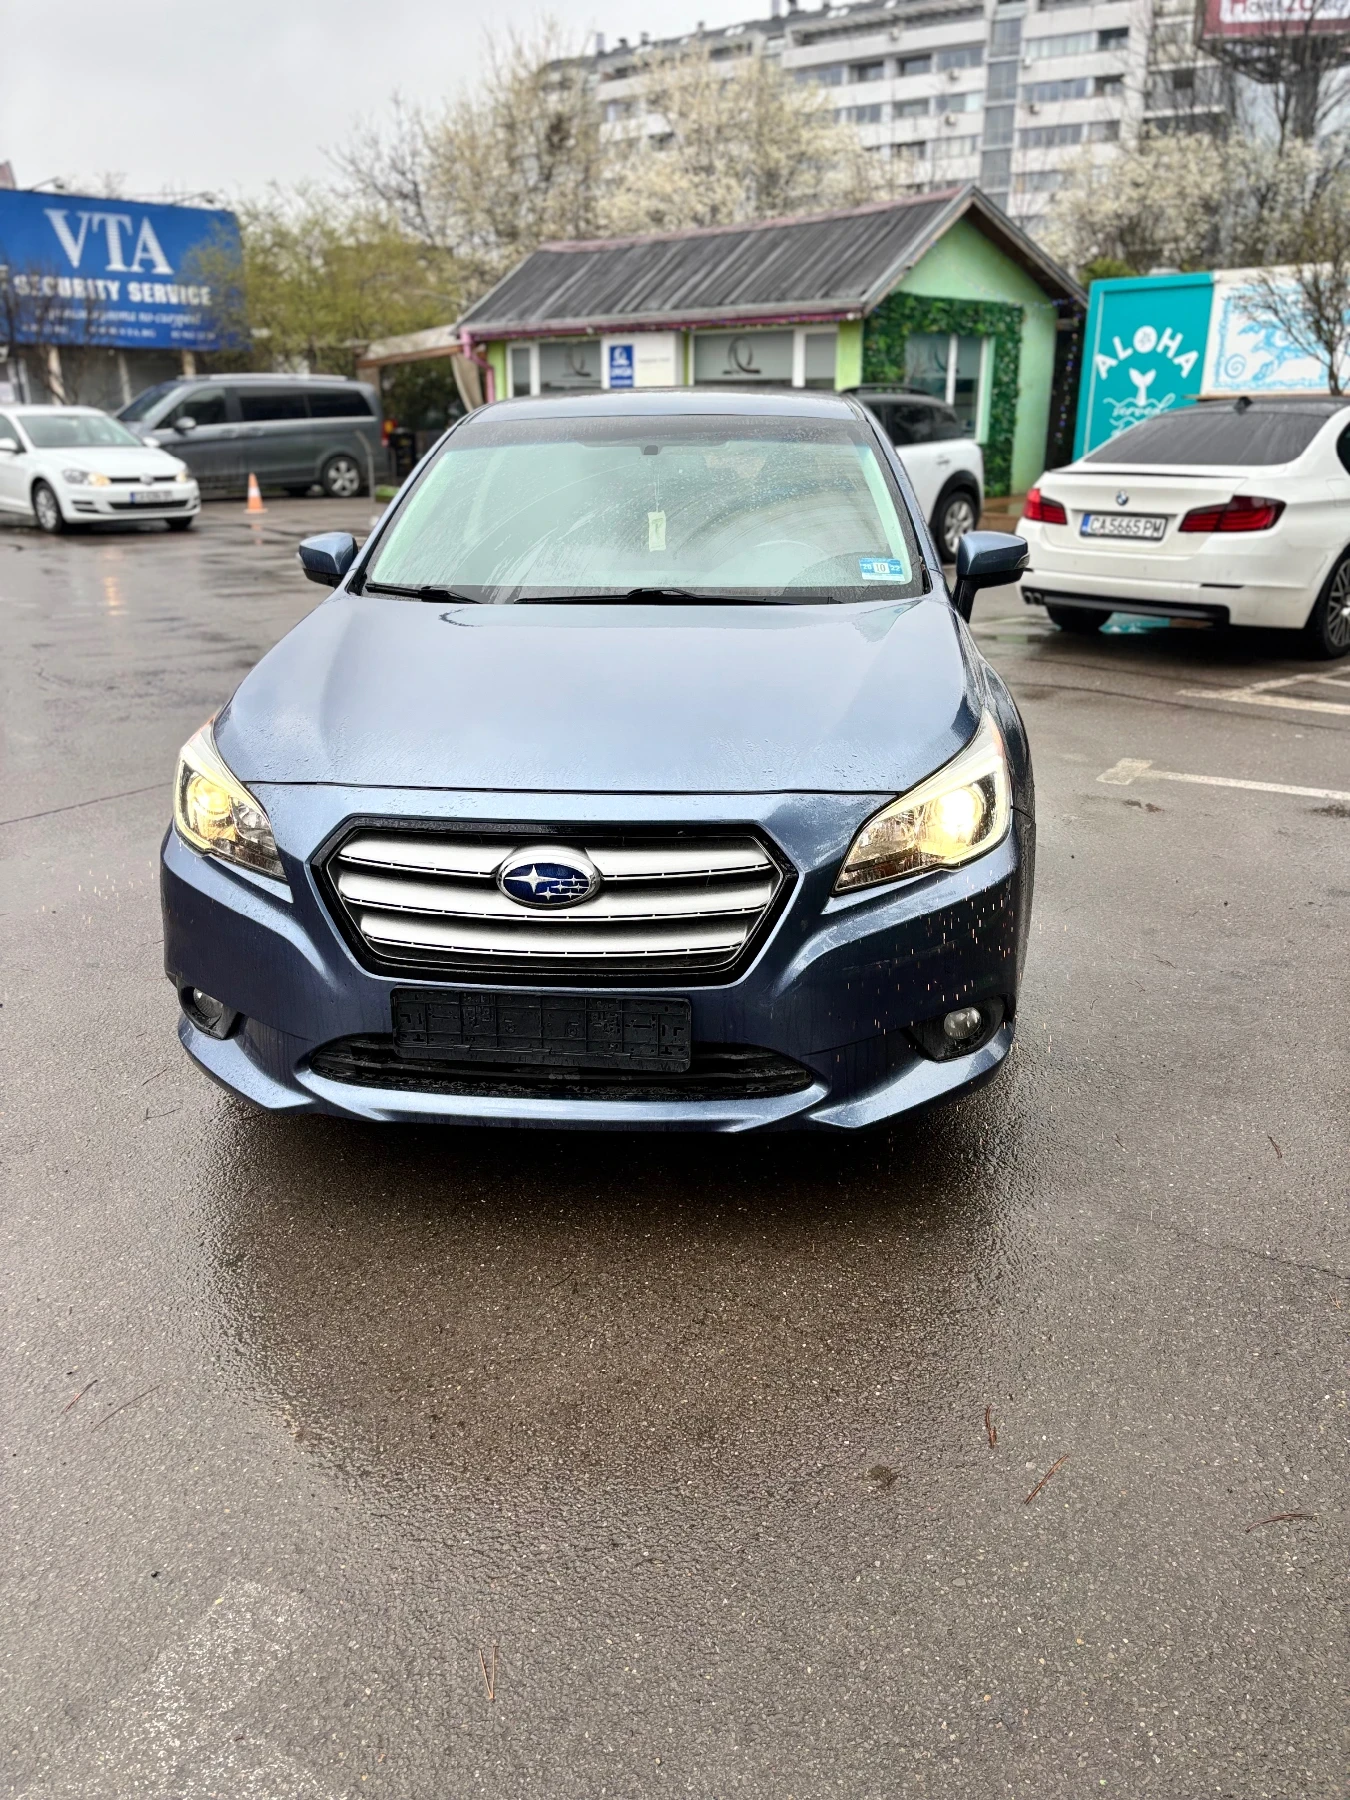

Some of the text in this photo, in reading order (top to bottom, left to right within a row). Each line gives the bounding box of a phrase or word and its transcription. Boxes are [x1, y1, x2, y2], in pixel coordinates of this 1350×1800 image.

[44, 208, 174, 275] VTA
[13, 274, 121, 301] SECURITY
[127, 281, 213, 305] SERVICE
[1095, 325, 1199, 380] ALOHA
